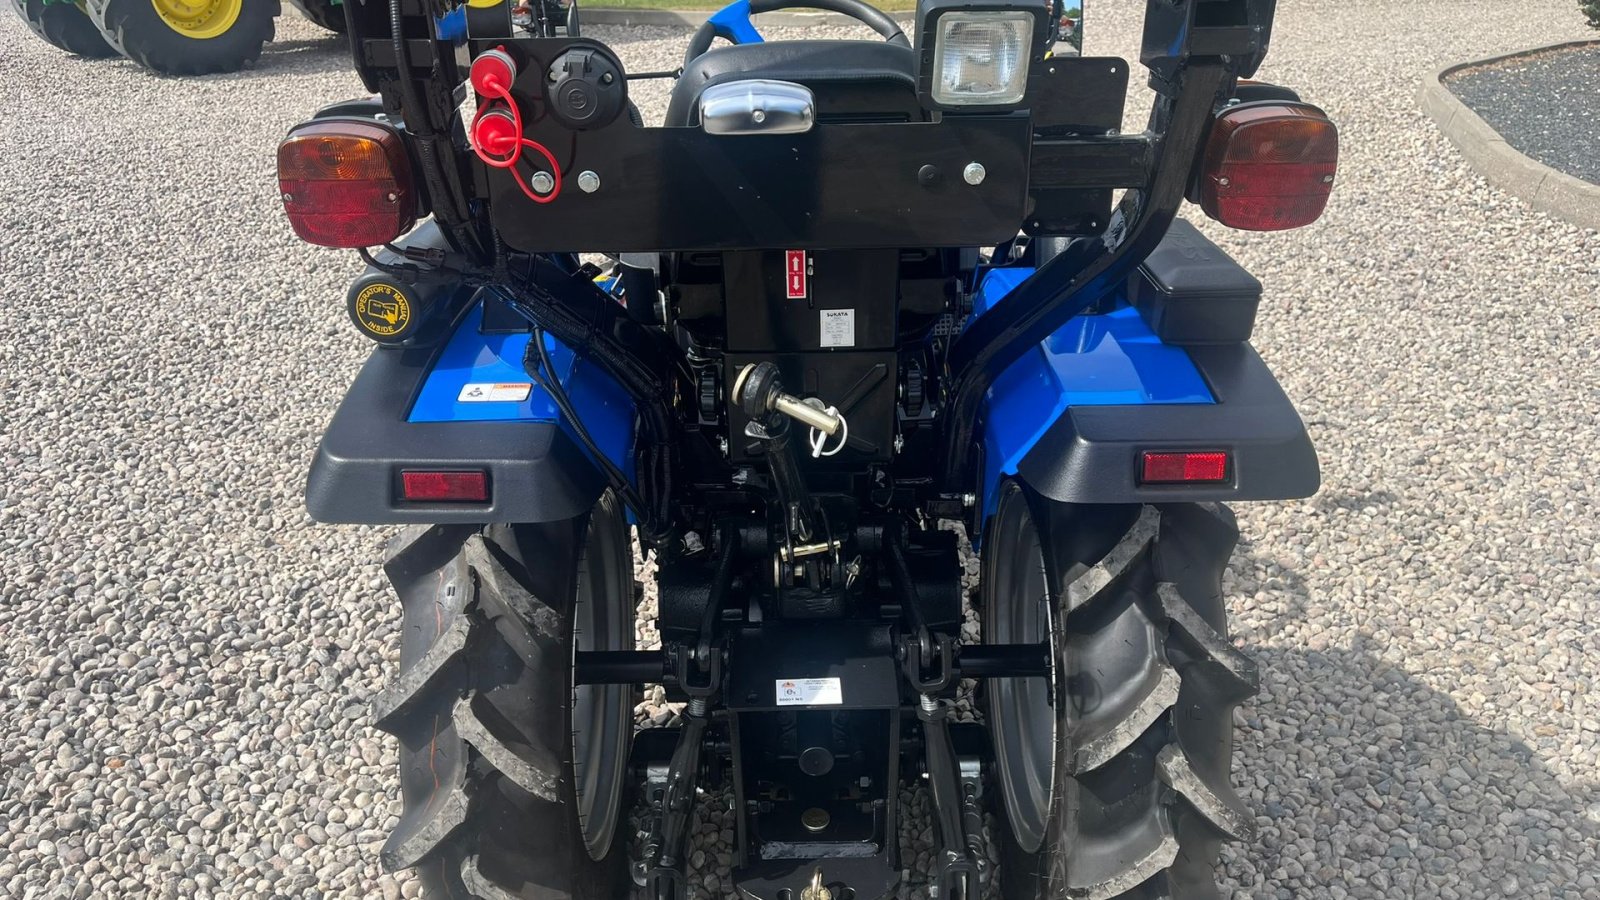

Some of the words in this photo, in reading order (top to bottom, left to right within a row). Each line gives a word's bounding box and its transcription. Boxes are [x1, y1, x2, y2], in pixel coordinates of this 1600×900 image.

[359, 286, 391, 313] OPERATOR'S
[393, 292, 408, 321] MANUAL
[367, 321, 395, 333] INSIDE
